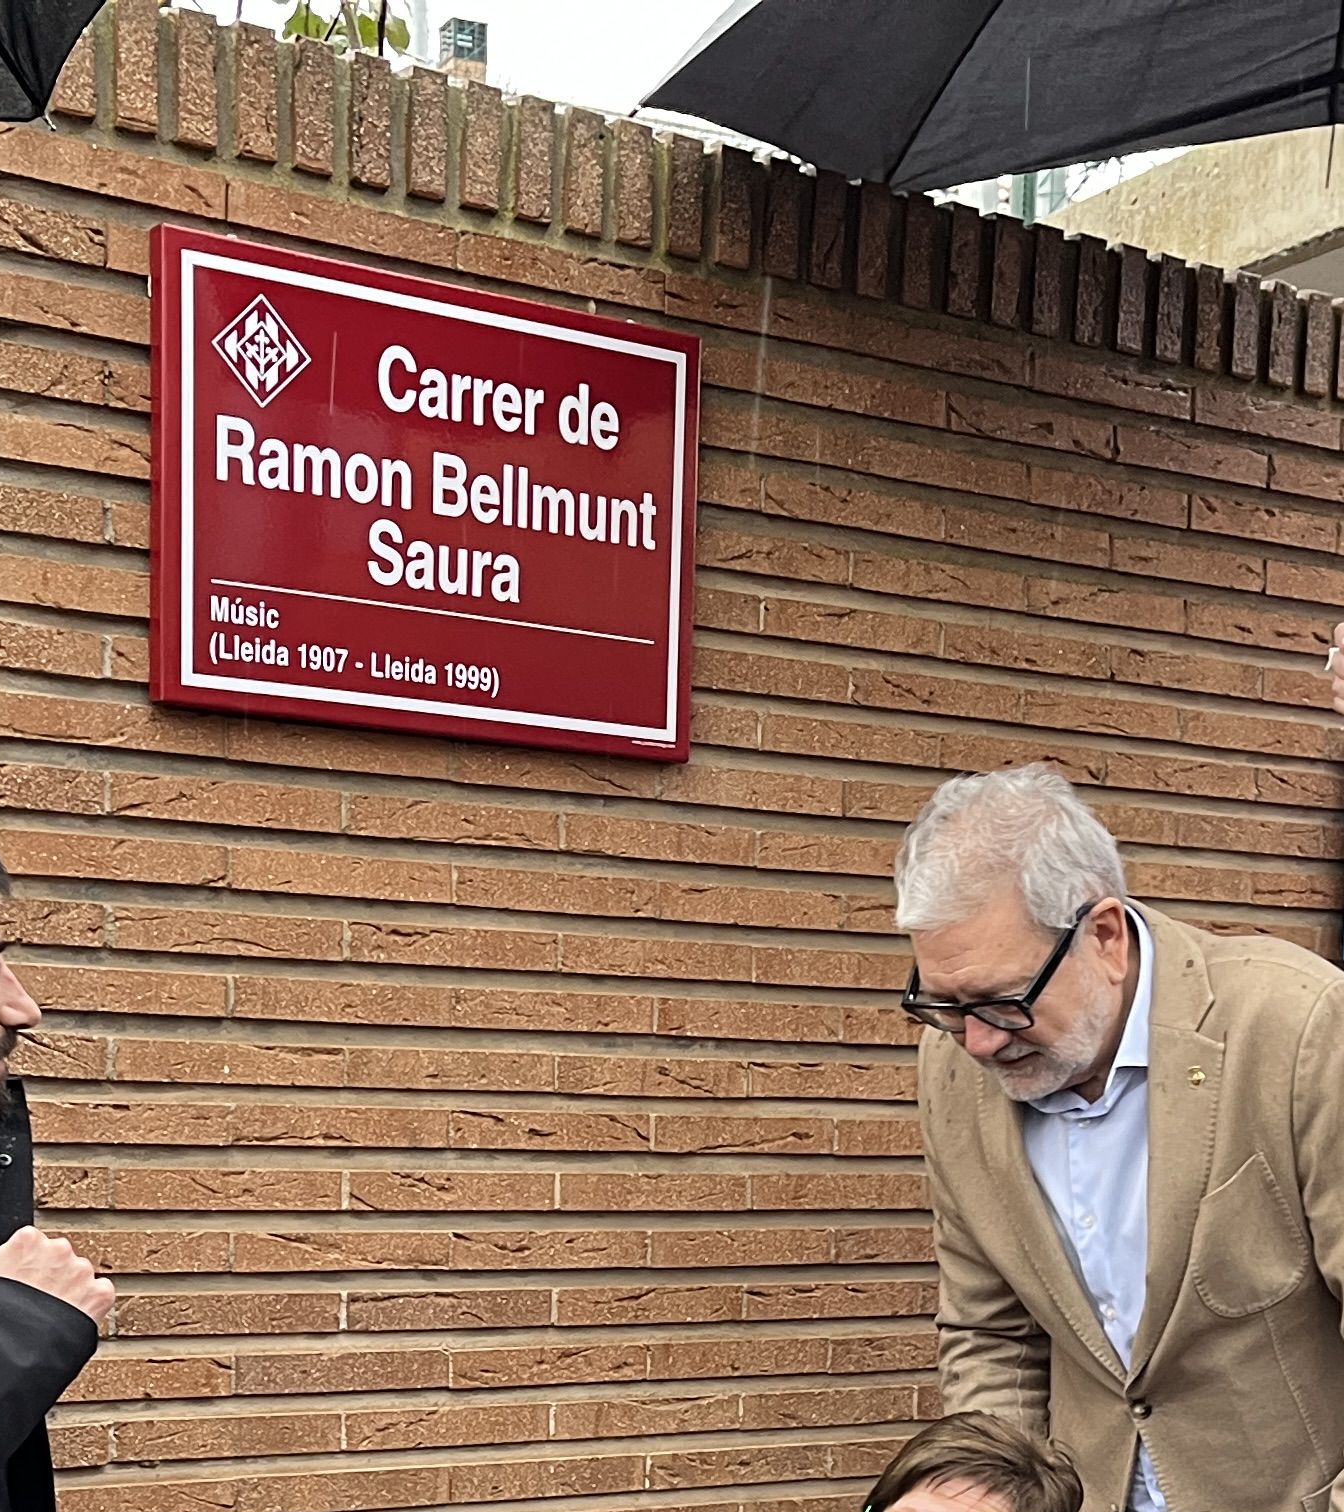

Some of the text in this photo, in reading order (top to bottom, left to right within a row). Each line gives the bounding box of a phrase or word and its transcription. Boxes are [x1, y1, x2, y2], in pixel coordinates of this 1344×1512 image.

[377, 344, 620, 451] Carrer de
[215, 414, 657, 551] Ramon Bellmunt
[367, 519, 521, 604] Saura
[210, 595, 280, 629] Músic
[209, 632, 289, 667] (Lleida
[297, 643, 349, 673] 1907
[370, 651, 437, 685] Lleida
[444, 662, 500, 699] 1999)
